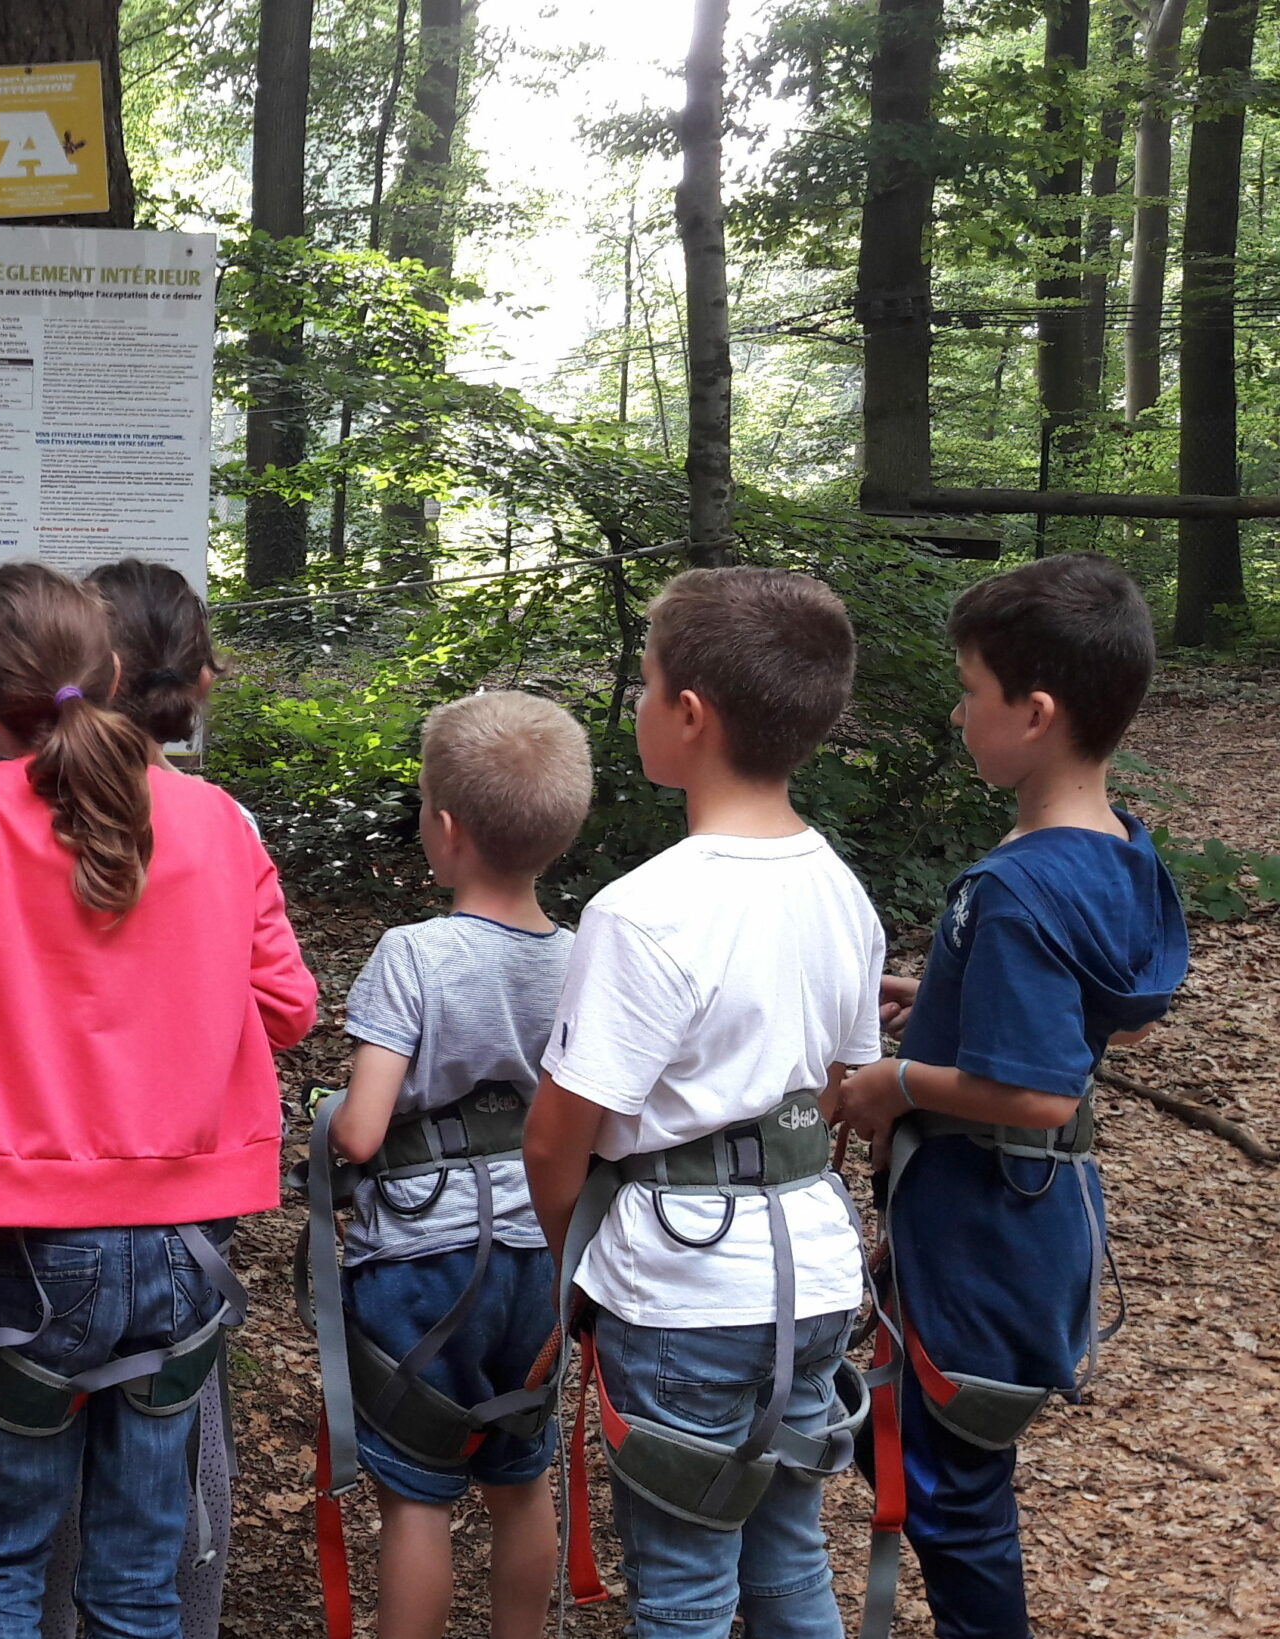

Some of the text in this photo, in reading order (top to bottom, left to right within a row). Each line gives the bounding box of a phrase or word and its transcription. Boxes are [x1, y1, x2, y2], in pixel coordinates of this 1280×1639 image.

[100, 265, 201, 286] INTÉRIEUR
[22, 288, 57, 297] activités
[58, 289, 94, 301] implique
[96, 289, 148, 301] l'acceptation
[150, 291, 161, 300] de
[172, 291, 203, 301] dernier
